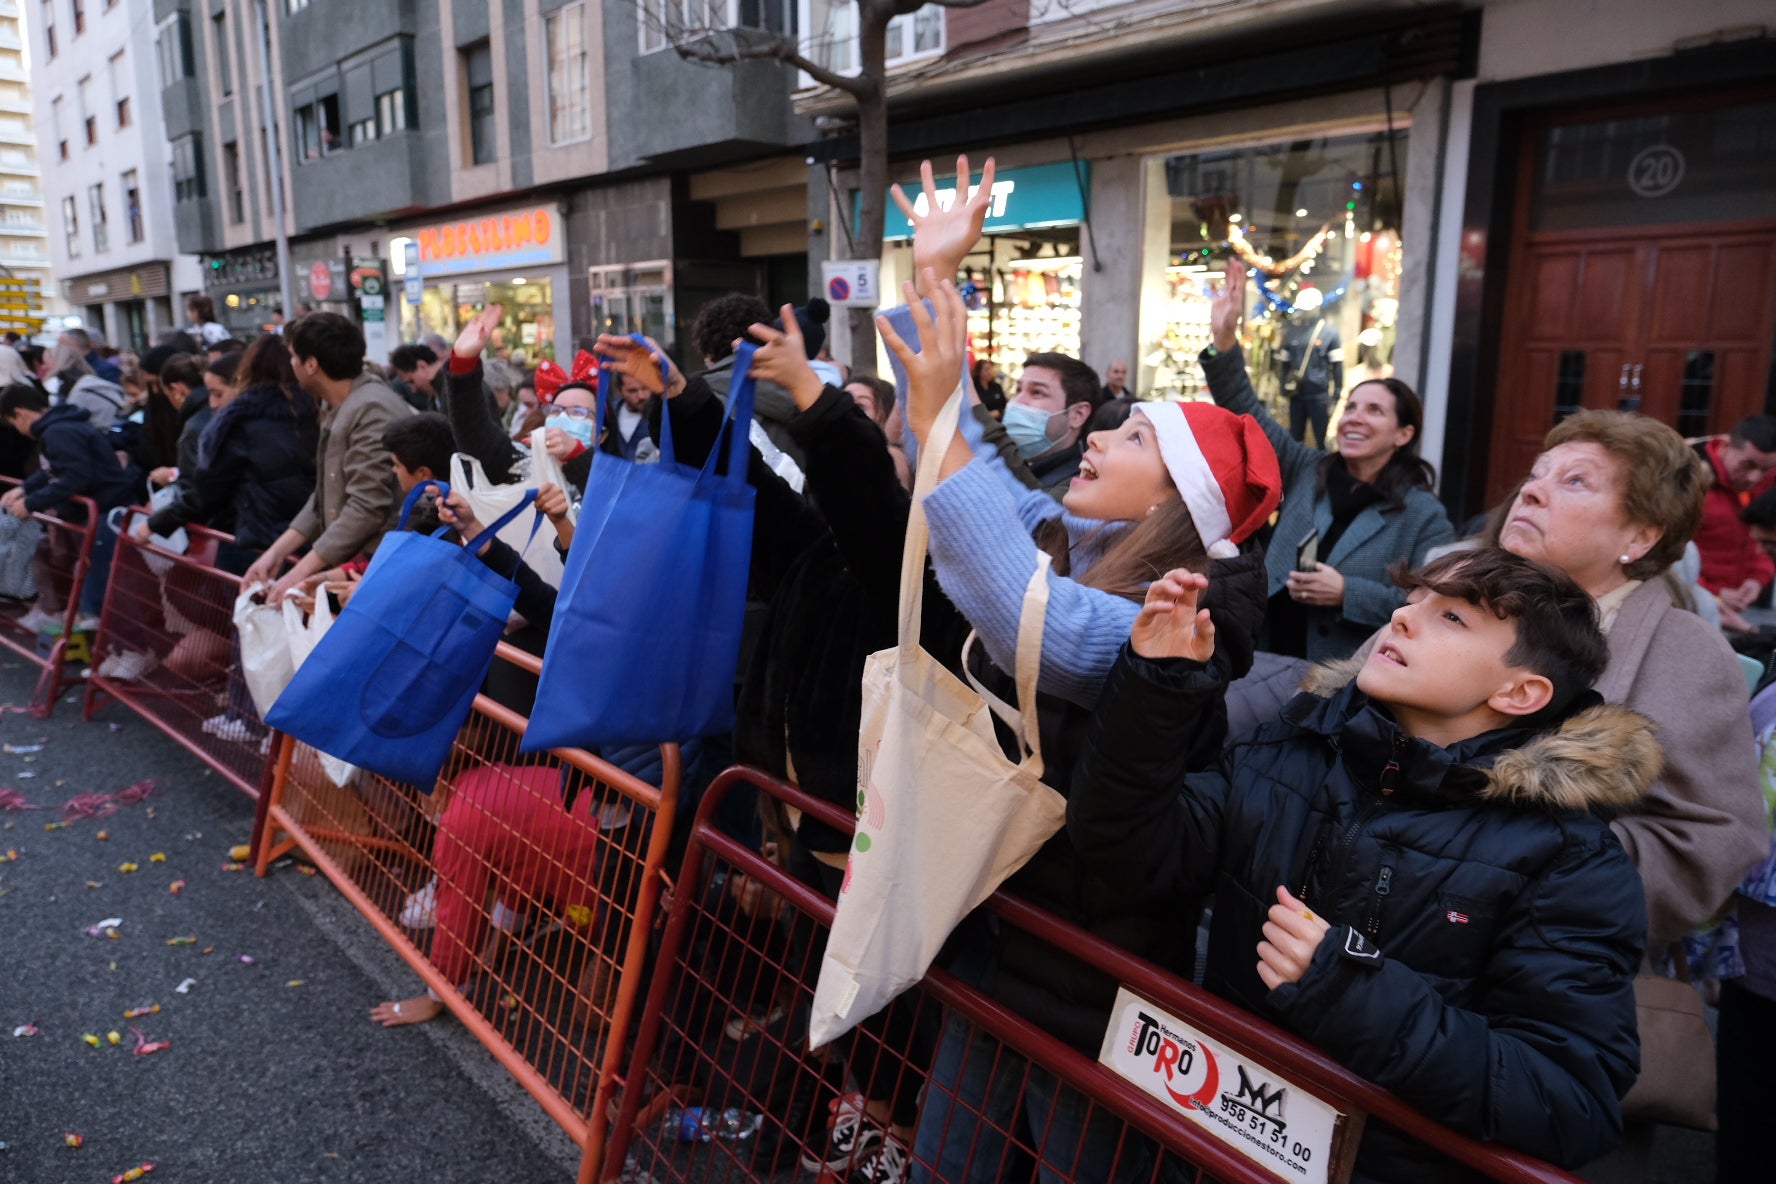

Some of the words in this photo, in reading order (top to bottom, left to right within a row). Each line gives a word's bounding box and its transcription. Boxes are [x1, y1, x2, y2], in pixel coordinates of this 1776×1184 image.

[1640, 155, 1674, 187] 20
[858, 273, 868, 288] 5
[1128, 1021, 1141, 1053] GRUPO
[1160, 1023, 1197, 1052] Hermanos
[1190, 1098, 1307, 1175] info@produccionestoro.com
[1220, 1098, 1246, 1123] 958
[1249, 1115, 1266, 1136] 51
[1270, 1128, 1288, 1149] 51
[1292, 1142, 1311, 1162] 00
